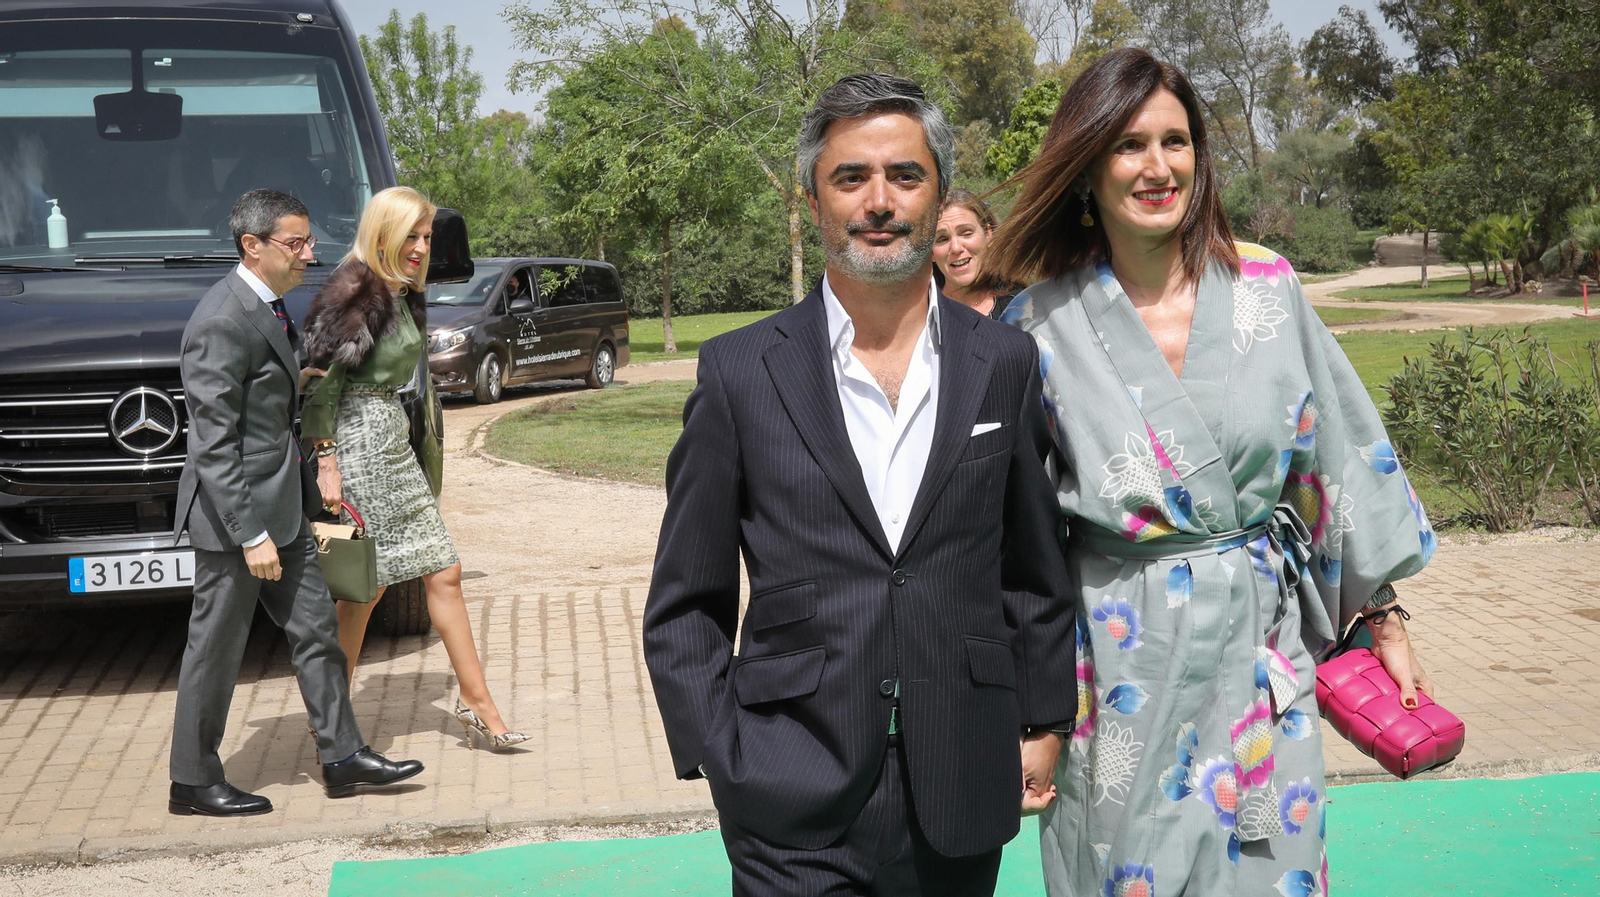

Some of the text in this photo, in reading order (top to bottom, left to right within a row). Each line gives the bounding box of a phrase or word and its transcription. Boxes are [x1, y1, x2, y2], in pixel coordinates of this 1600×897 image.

[515, 349, 581, 366] www.hotelsierradeubrique.com
[91, 559, 164, 587] 3126
[74, 578, 81, 586] E
